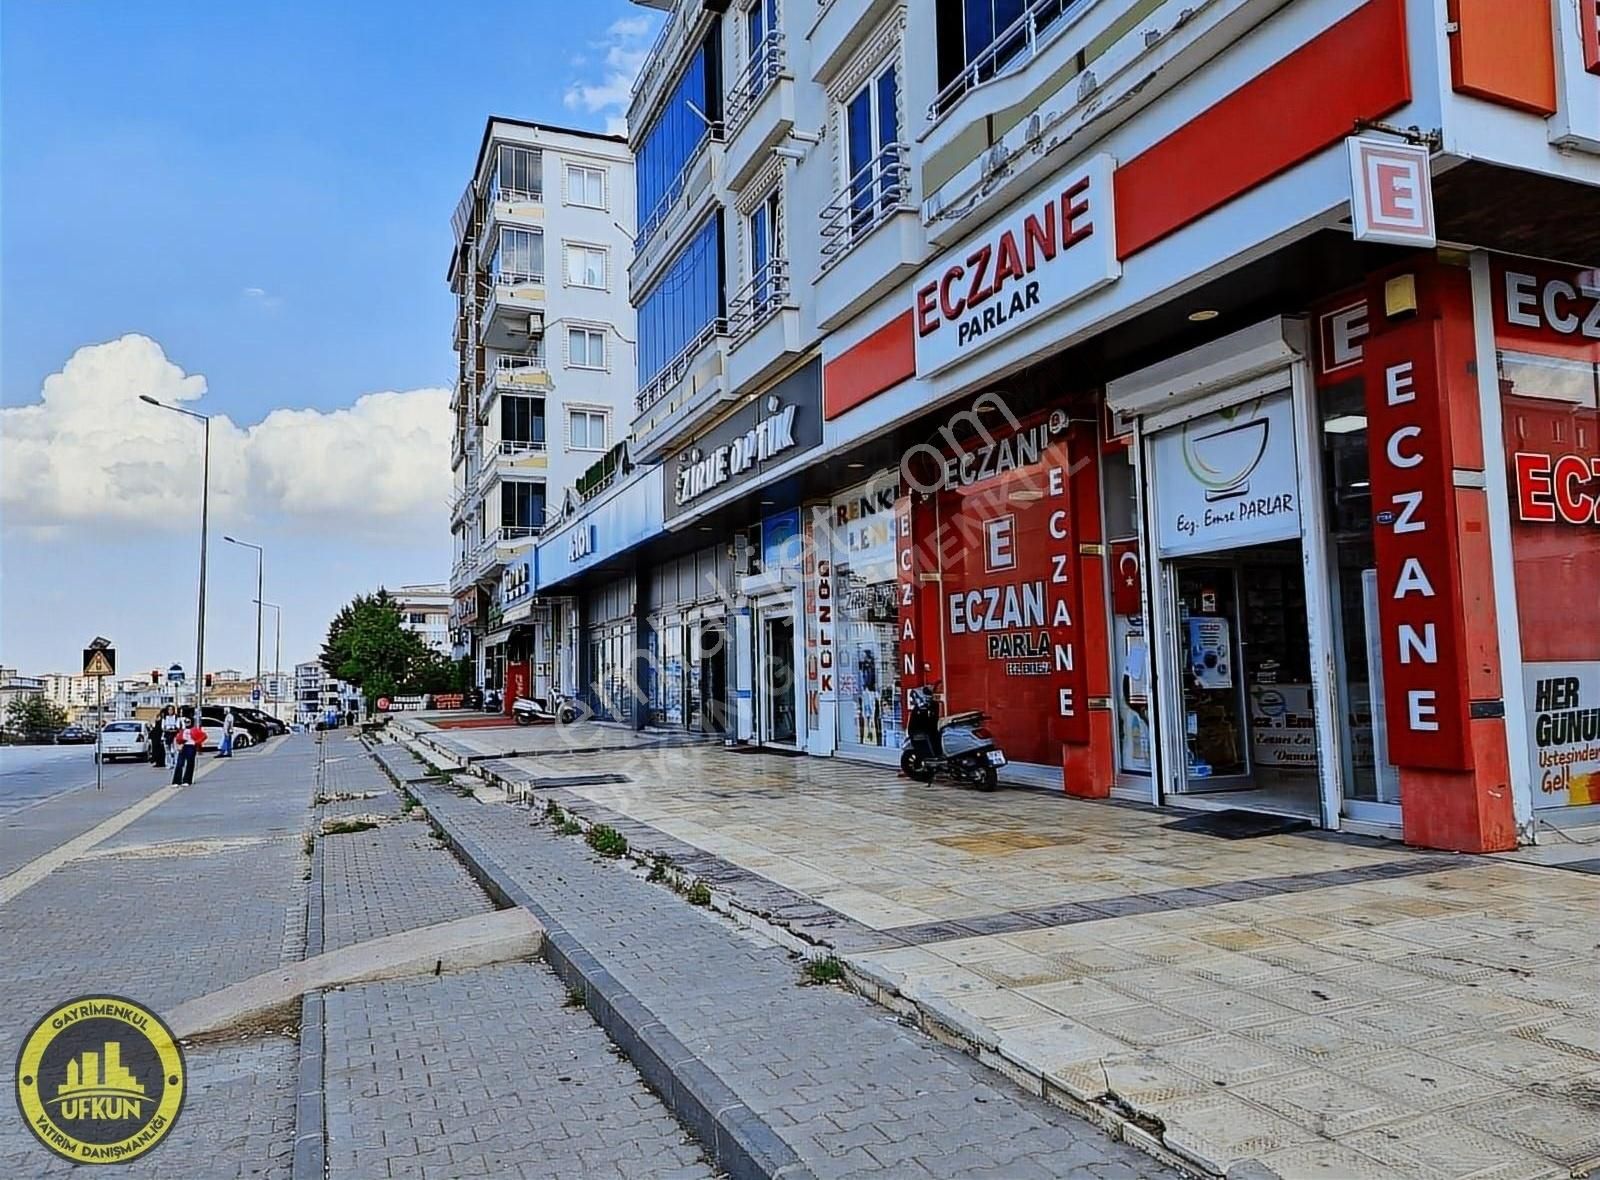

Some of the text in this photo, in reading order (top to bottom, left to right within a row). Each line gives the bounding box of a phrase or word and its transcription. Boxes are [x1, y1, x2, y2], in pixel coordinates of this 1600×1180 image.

[1376, 163, 1415, 220] E
[916, 175, 1094, 338] ECZANE
[958, 281, 1040, 347] PARLAR
[1239, 493, 1294, 522] PARLAR
[1514, 452, 1600, 524] EC
[1386, 361, 1440, 731] ECZANE
[950, 580, 1051, 635] ECZAN
[1049, 466, 1075, 716] ECZANE
[987, 632, 1051, 660] PARLA
[1535, 676, 1580, 712] HER
[1536, 707, 1600, 748] GÜNÜ
